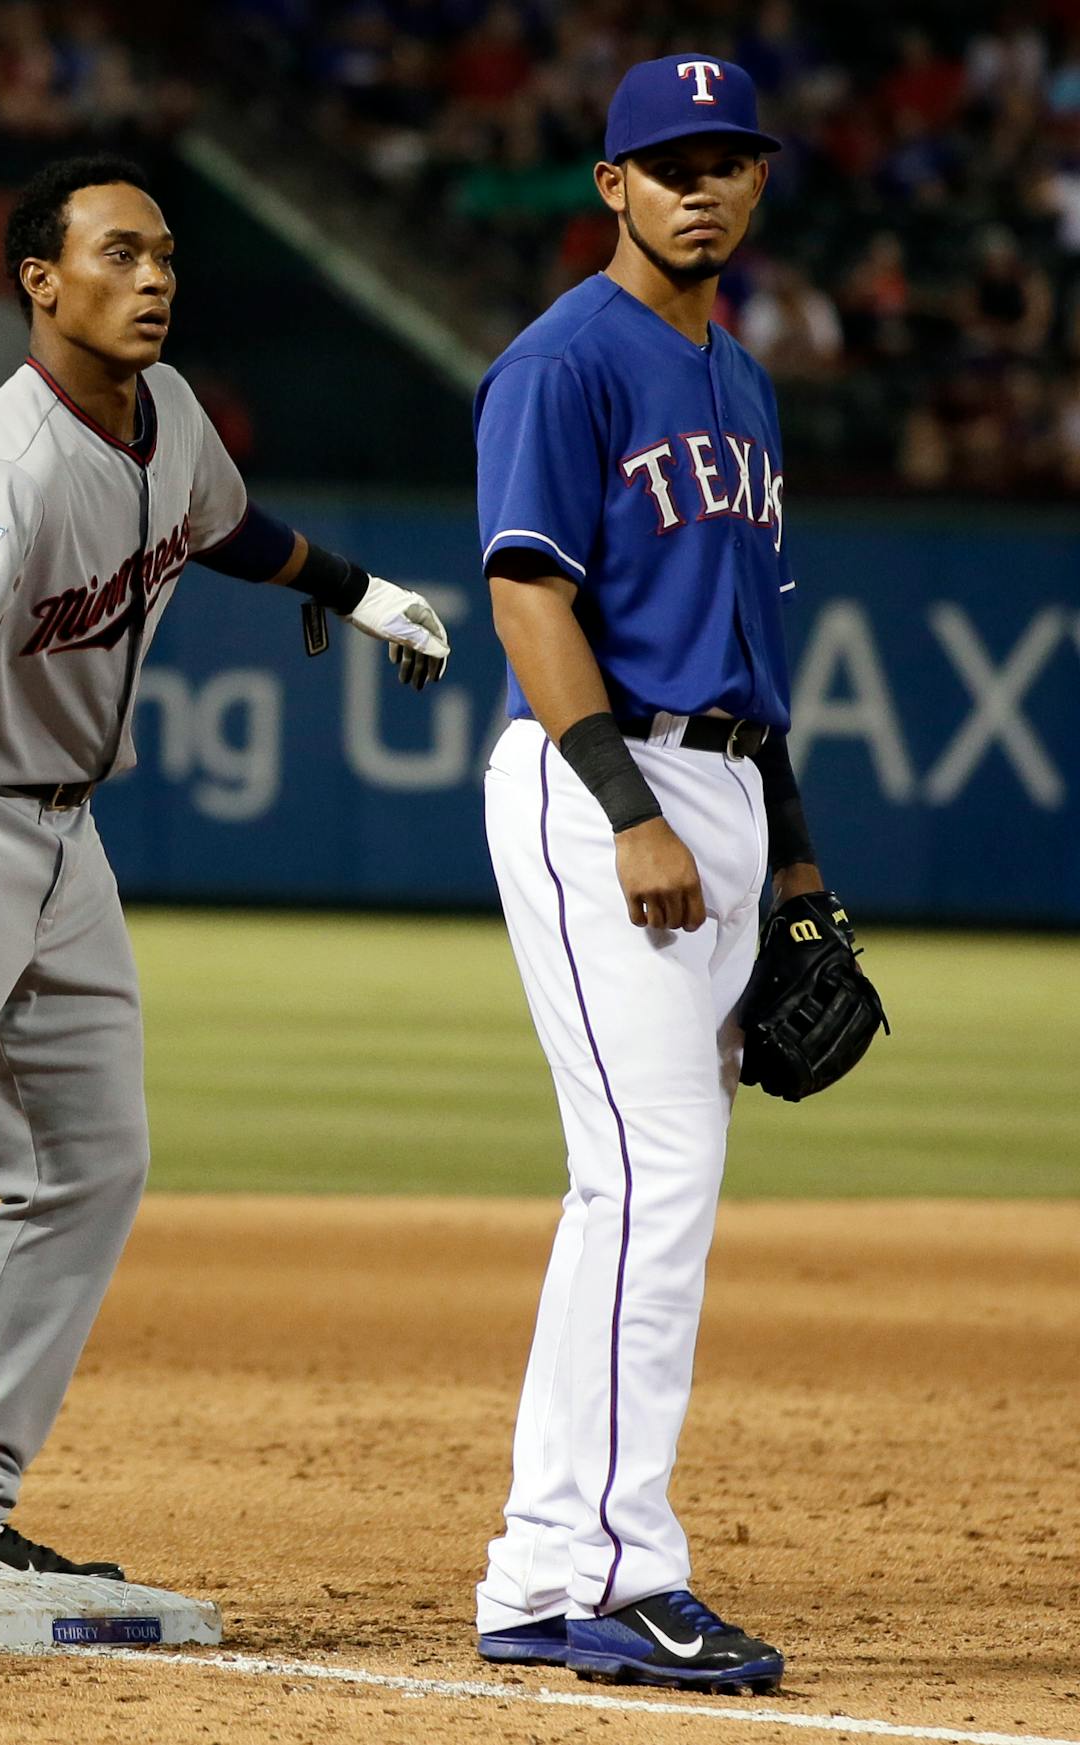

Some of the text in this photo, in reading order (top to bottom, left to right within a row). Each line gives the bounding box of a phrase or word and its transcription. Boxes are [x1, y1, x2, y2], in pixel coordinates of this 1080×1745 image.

[677, 61, 724, 105] T
[619, 430, 784, 554] TEXAS
[55, 1626, 158, 1640] THIRTY TOUR
